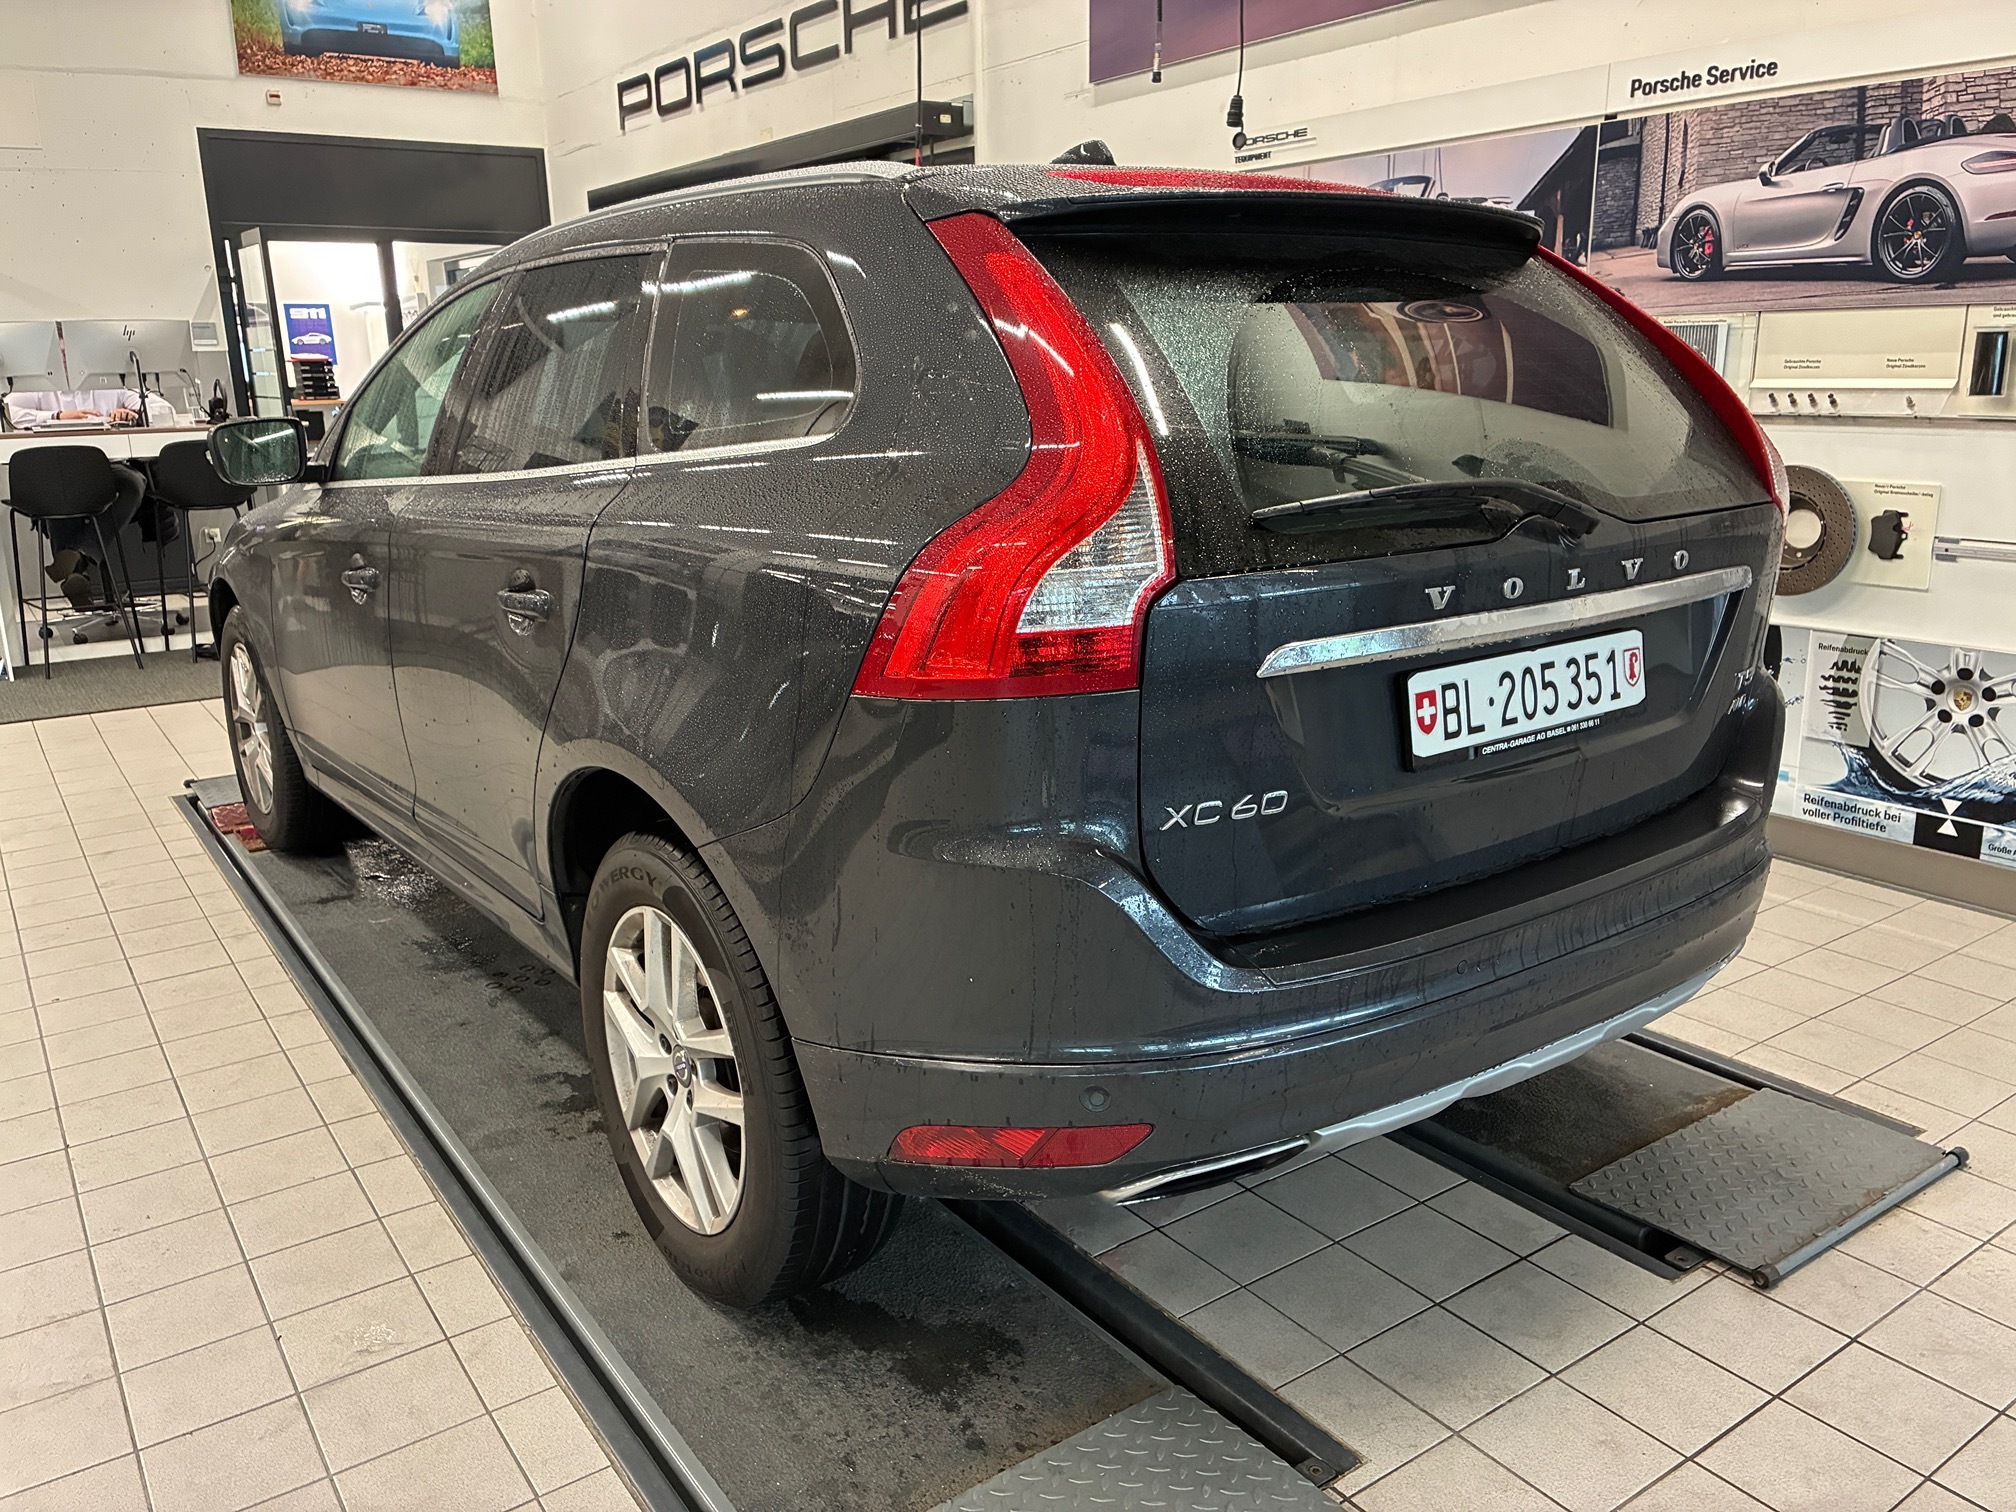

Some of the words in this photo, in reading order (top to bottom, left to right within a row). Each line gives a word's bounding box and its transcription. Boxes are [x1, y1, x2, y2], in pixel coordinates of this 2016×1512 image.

[1630, 70, 1702, 98] Porsche
[1706, 58, 1778, 86] Service
[1245, 127, 1308, 146] ORSCHE
[123, 324, 135, 341] hp
[1425, 549, 1690, 611] VOLVO
[1818, 642, 1869, 656] Reifenabdruck
[1481, 734, 1536, 755] CENTRA-GARAGE
[1536, 731, 1547, 742] AG
[1546, 727, 1567, 740] BASEL
[1802, 808, 1832, 821] voller
[1832, 812, 1888, 834] Profiltiefe
[1803, 793, 1882, 819] Reifenabdruck
[1883, 810, 1902, 824] bei
[1987, 843, 2012, 855] Große
